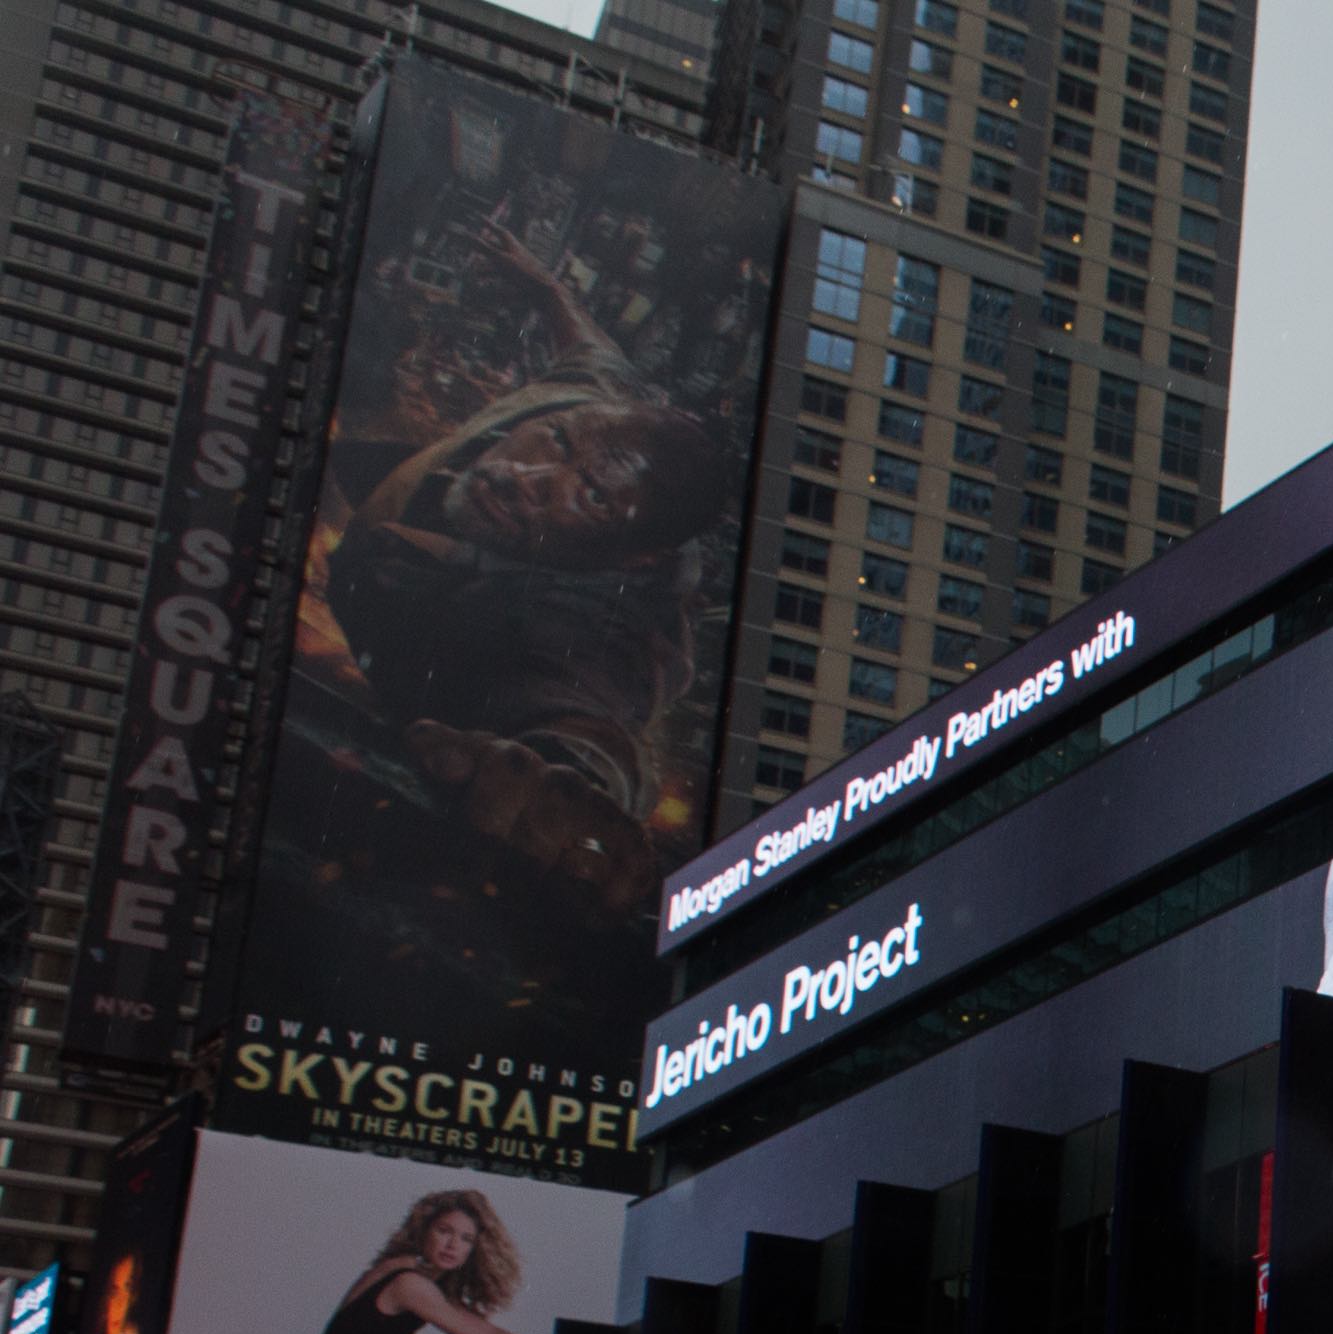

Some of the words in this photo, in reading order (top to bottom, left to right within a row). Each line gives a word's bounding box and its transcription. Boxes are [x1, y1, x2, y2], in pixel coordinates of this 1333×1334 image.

[194, 173, 307, 491] TIMES
[105, 528, 233, 950] SQUARE
[668, 857, 751, 932] Morgan
[753, 797, 842, 877] Stanley
[843, 733, 943, 822] Proudly
[945, 659, 1064, 759] Partners
[1071, 609, 1136, 680] with
[244, 1013, 430, 1061] DWAYNE
[645, 1002, 772, 1109] Jericho
[780, 902, 924, 1034] Project
[312, 1106, 339, 1128] IN
[349, 1111, 480, 1151] THEATERS
[485, 1132, 549, 1163] JULY
[554, 1147, 585, 1169] 13
